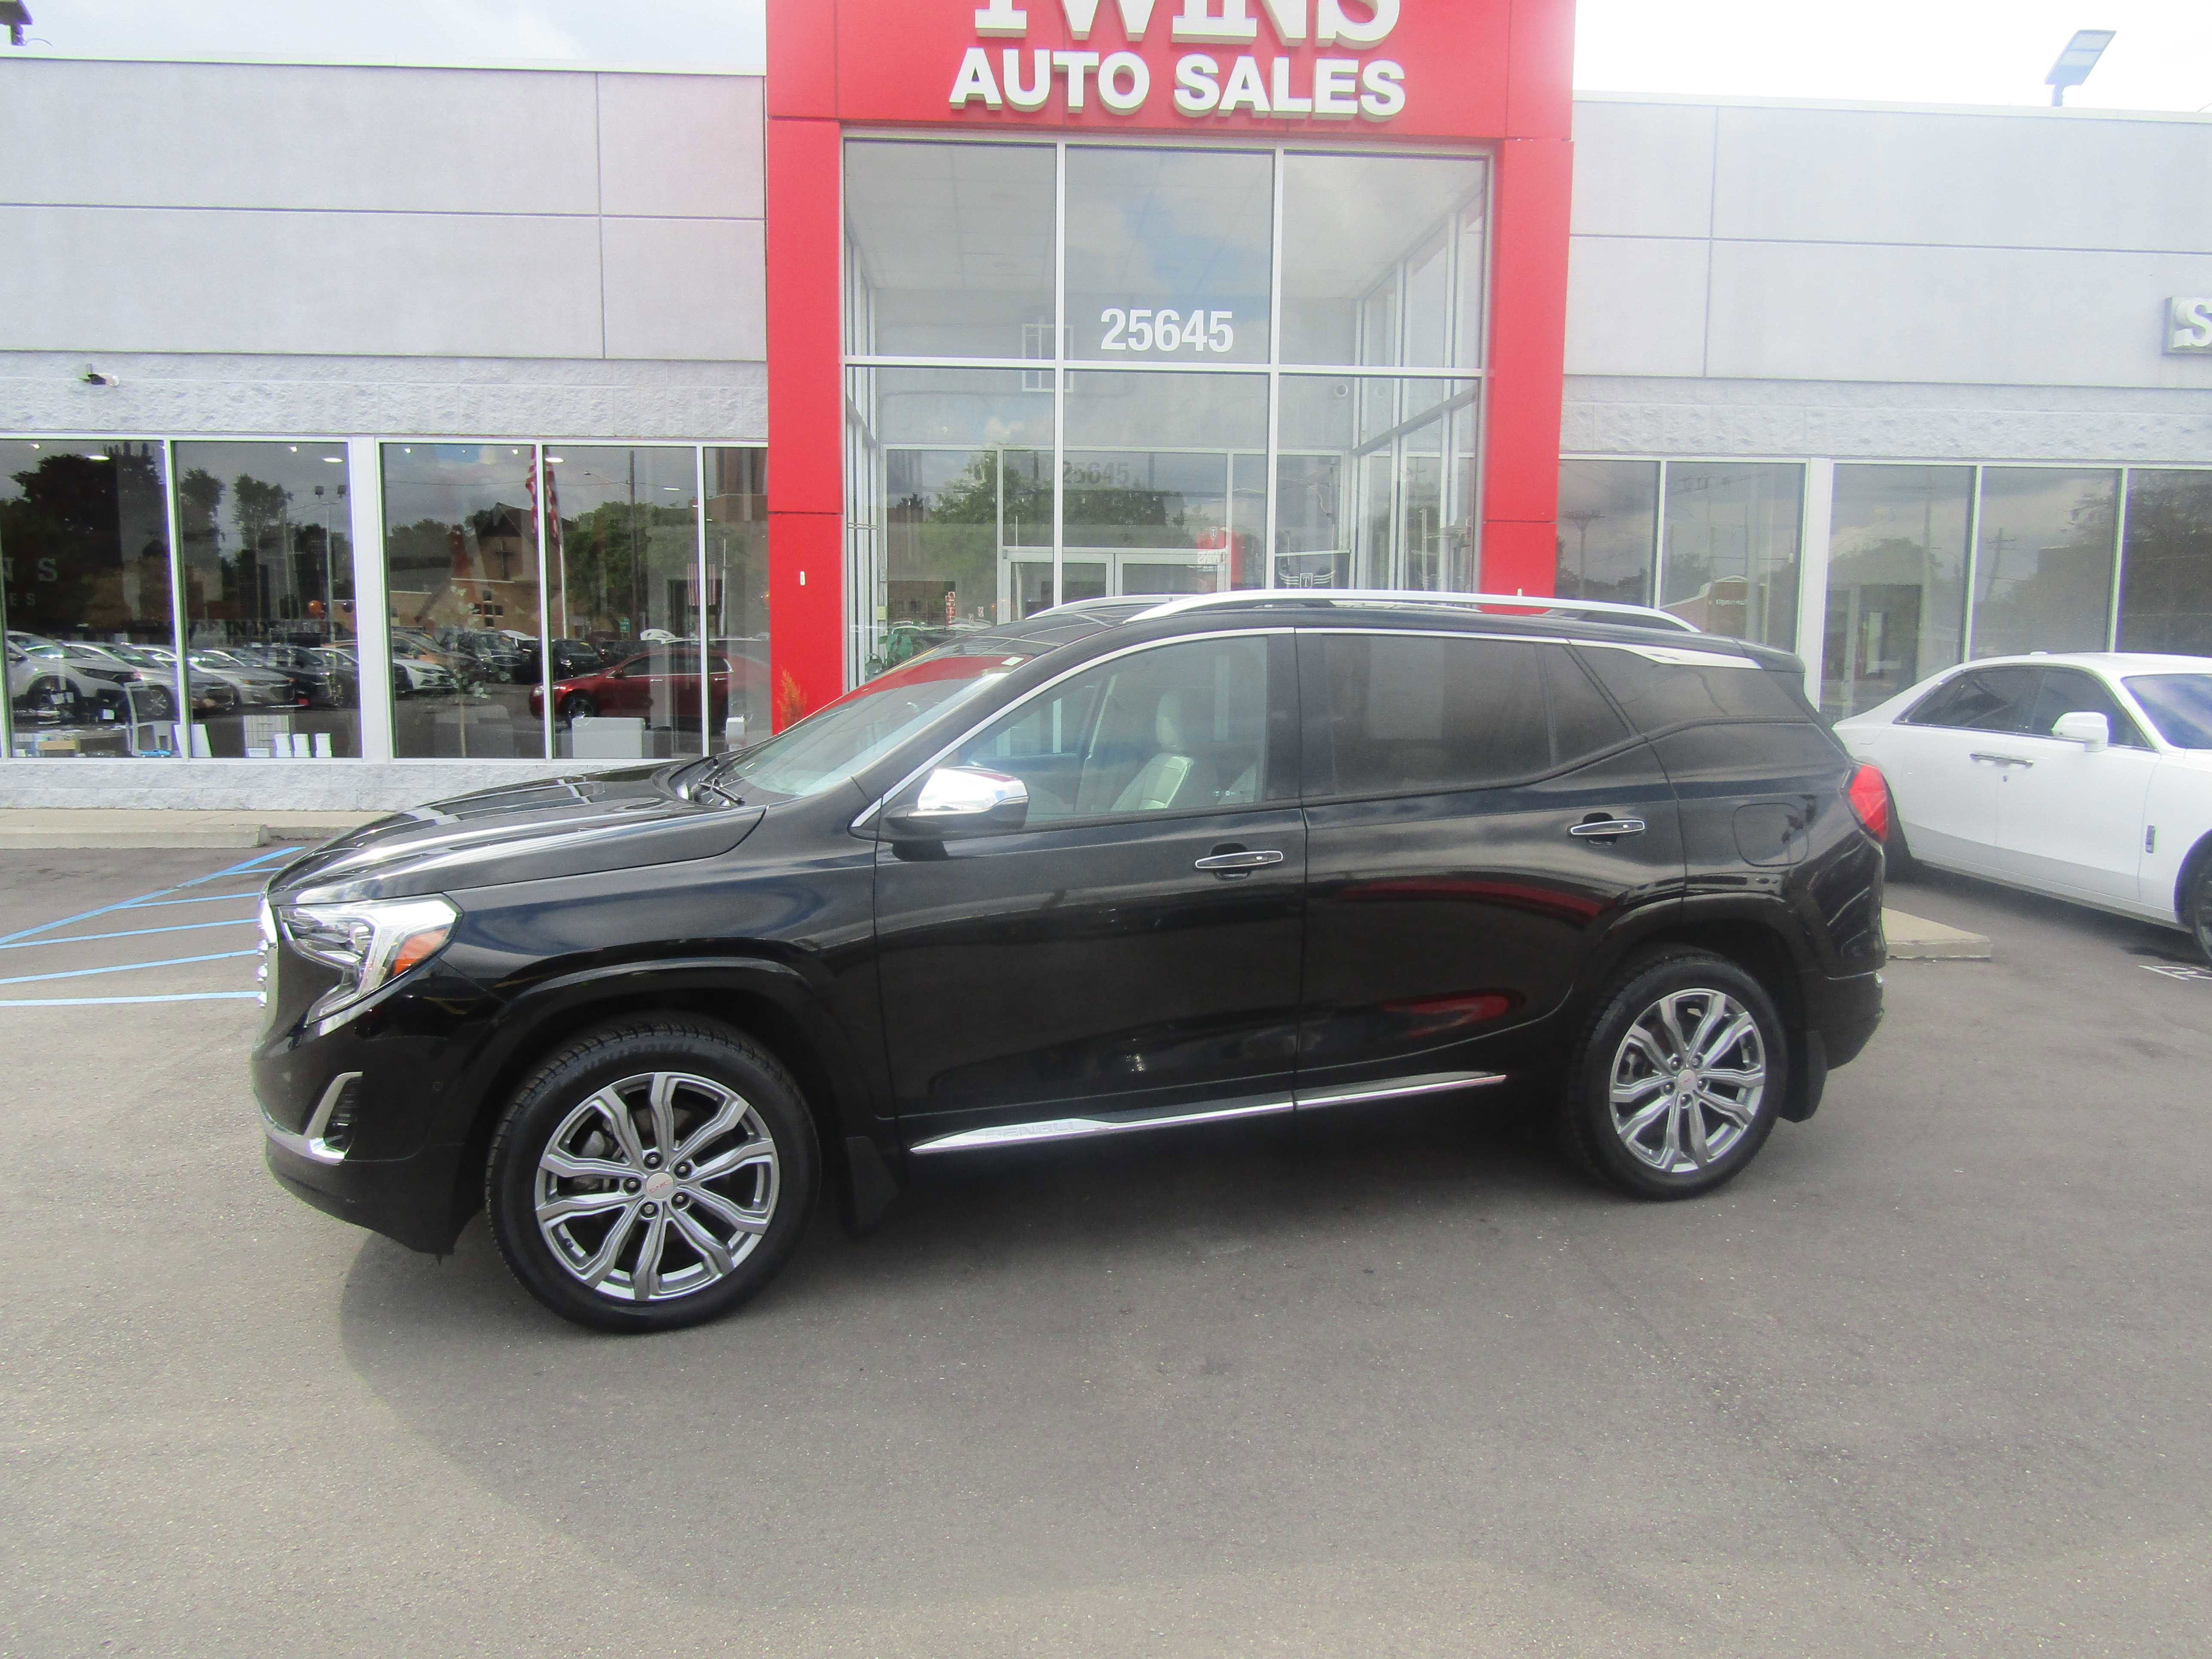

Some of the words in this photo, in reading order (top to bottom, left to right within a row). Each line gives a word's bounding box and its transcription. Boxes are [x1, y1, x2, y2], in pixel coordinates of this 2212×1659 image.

[949, 48, 1150, 115] AUTO
[1173, 53, 1405, 122] SALES
[1101, 308, 1234, 352] 25645
